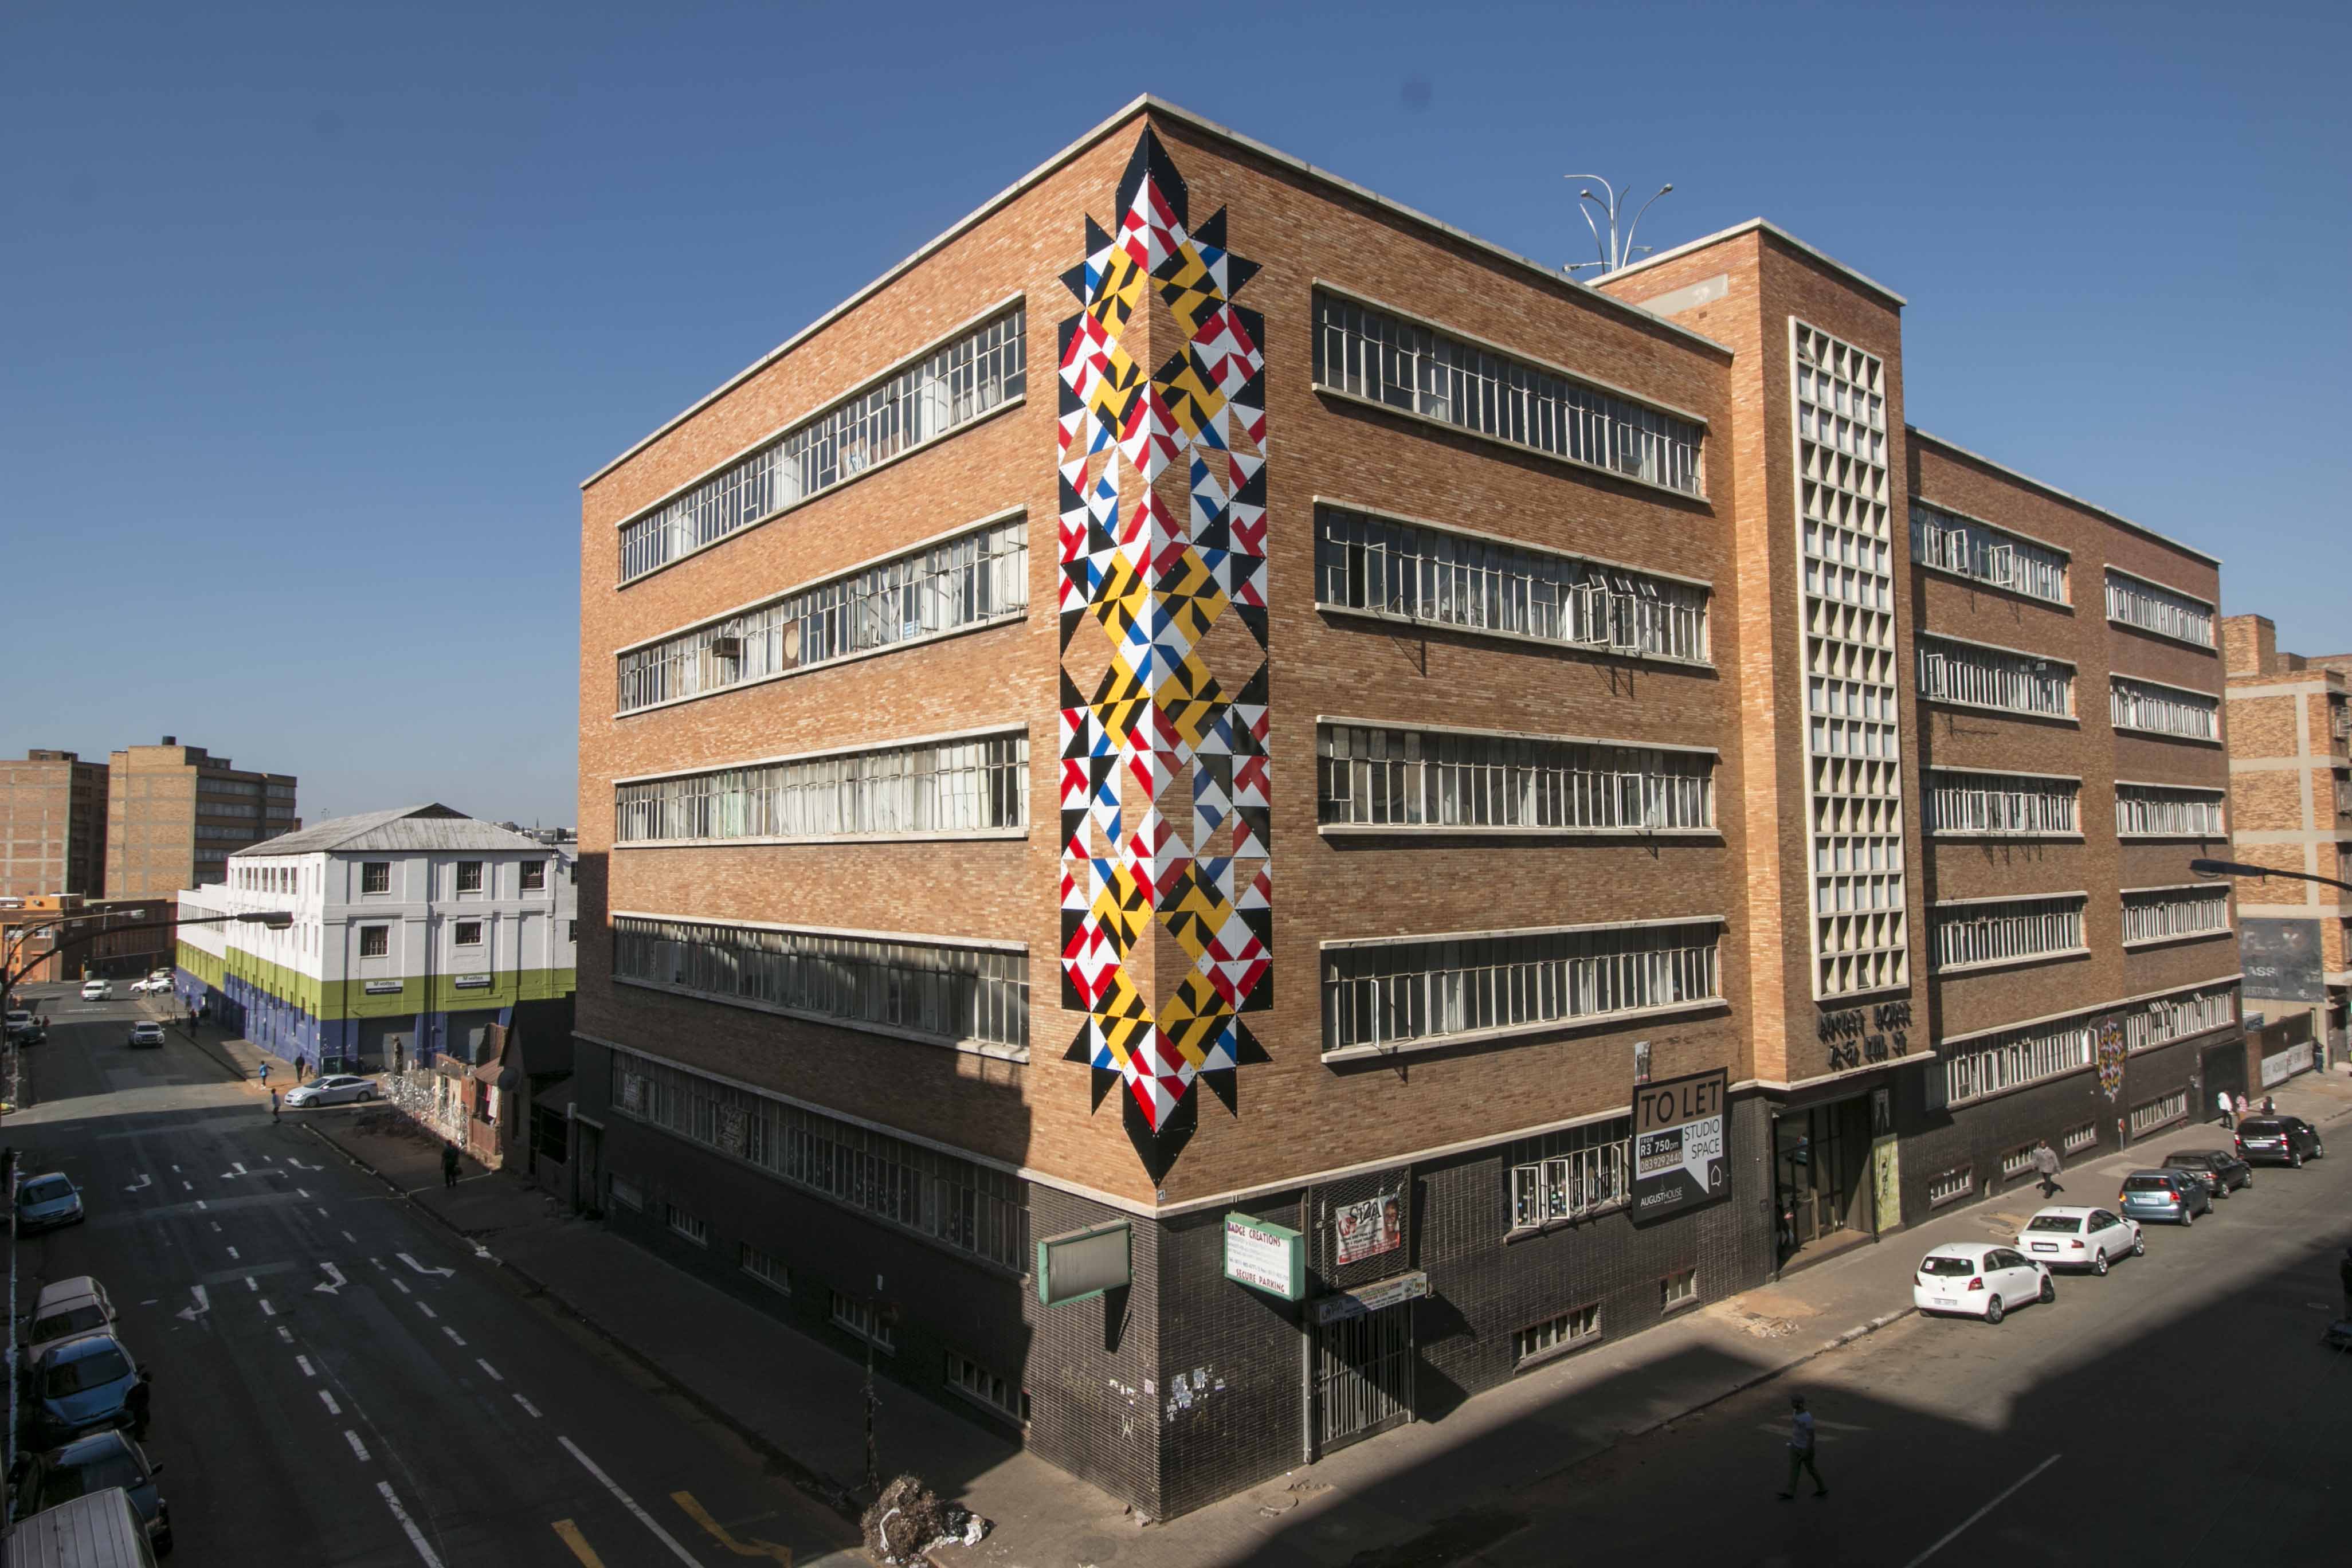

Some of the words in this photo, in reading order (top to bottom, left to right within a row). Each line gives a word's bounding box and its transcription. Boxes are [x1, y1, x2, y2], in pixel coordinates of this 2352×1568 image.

[1641, 1091, 1674, 1127] TO
[1683, 1080, 1721, 1118] LET
[1684, 1119, 1720, 1141] STUDIO
[1640, 1143, 1651, 1157] R3
[1691, 1138, 1720, 1159] SPACE
[1350, 1201, 1382, 1225] SIZA
[1228, 1222, 1245, 1237] BADGE
[1249, 1228, 1280, 1247] CREATIONS
[1236, 1269, 1256, 1284] SECURE
[1259, 1276, 1284, 1292] PARKING
